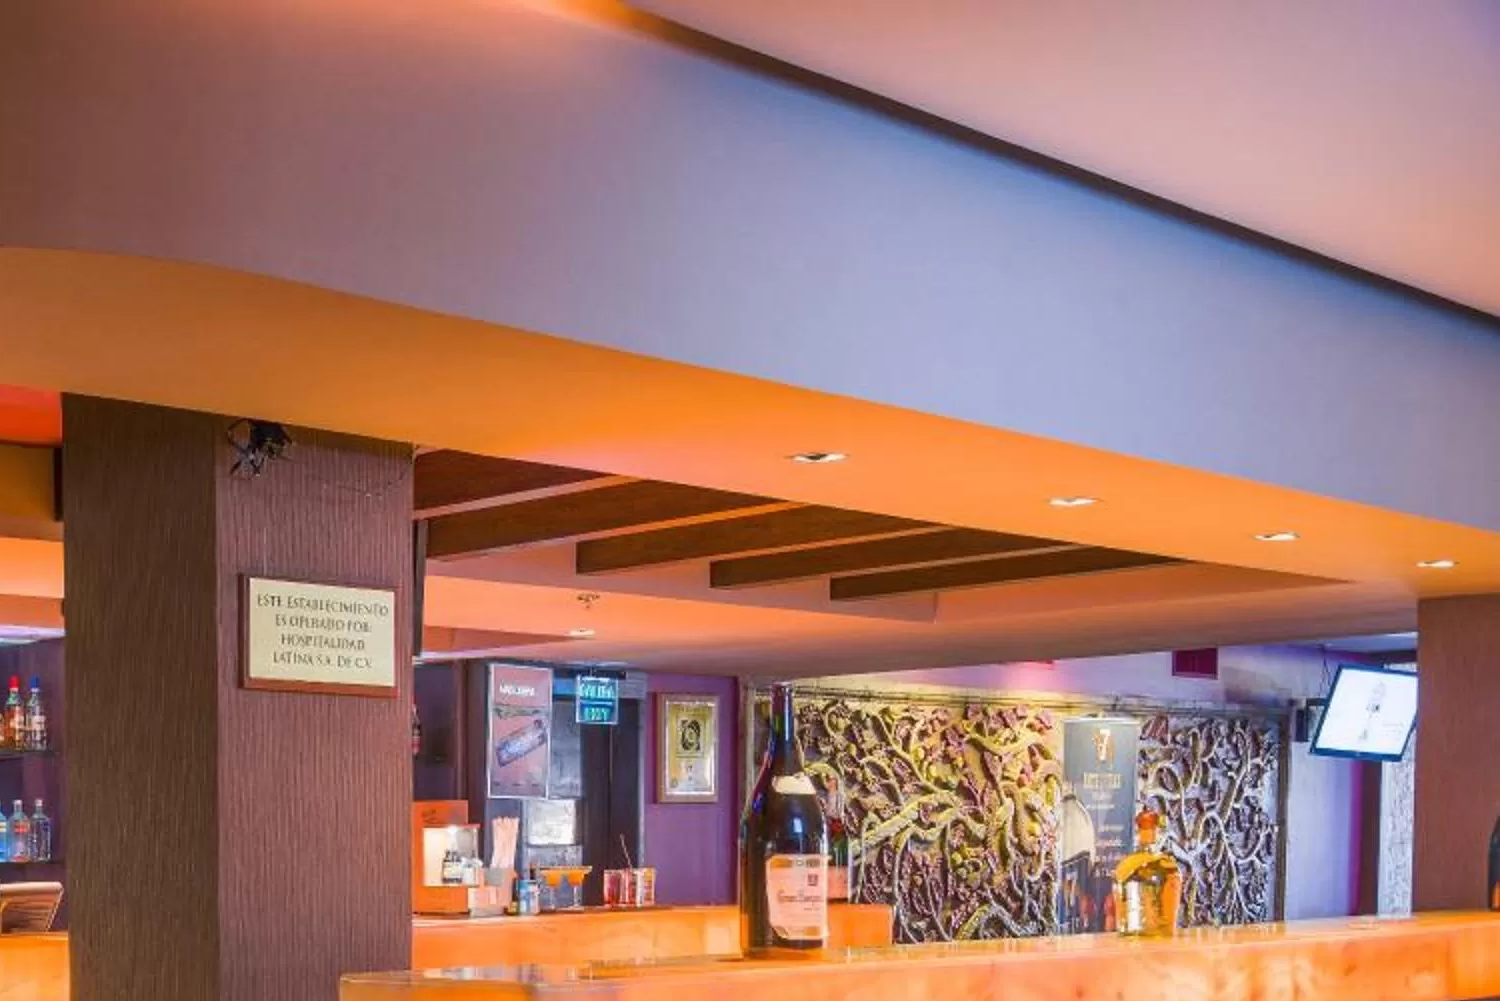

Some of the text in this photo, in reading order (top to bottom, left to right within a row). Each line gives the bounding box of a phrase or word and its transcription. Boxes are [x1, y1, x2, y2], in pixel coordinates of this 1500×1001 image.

[257, 593, 389, 617] ESTE ESTABLECIMIENTO
[275, 614, 287, 626] ES
[289, 615, 345, 631] OPERADO
[281, 633, 365, 651] HOSPITALIDAD
[273, 651, 313, 666] LATINA
